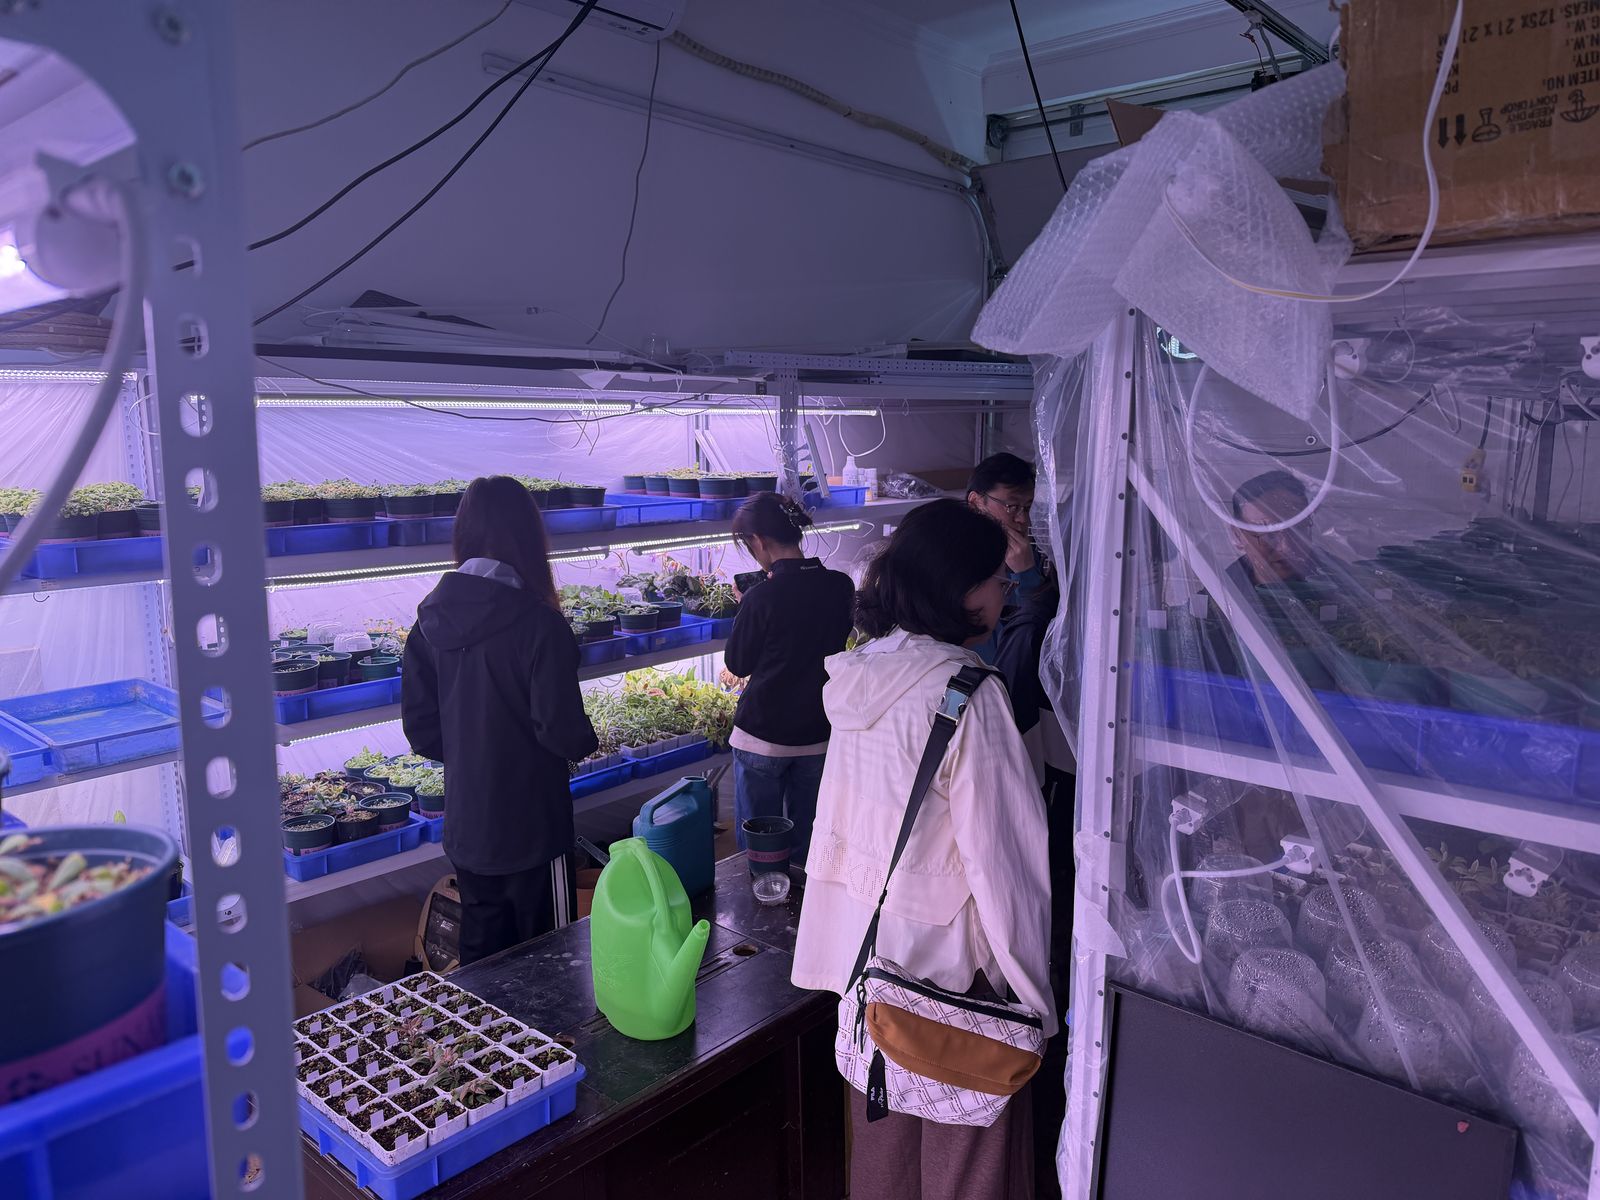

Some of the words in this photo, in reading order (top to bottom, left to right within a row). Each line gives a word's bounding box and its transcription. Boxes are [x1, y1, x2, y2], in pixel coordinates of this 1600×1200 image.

[1497, 18, 1515, 35] 21
[1568, 69, 1600, 87] ITEM
[1500, 101, 1528, 115] DROP
[1527, 105, 1555, 120] KEEP
[1509, 118, 1553, 134] FRAGILE
